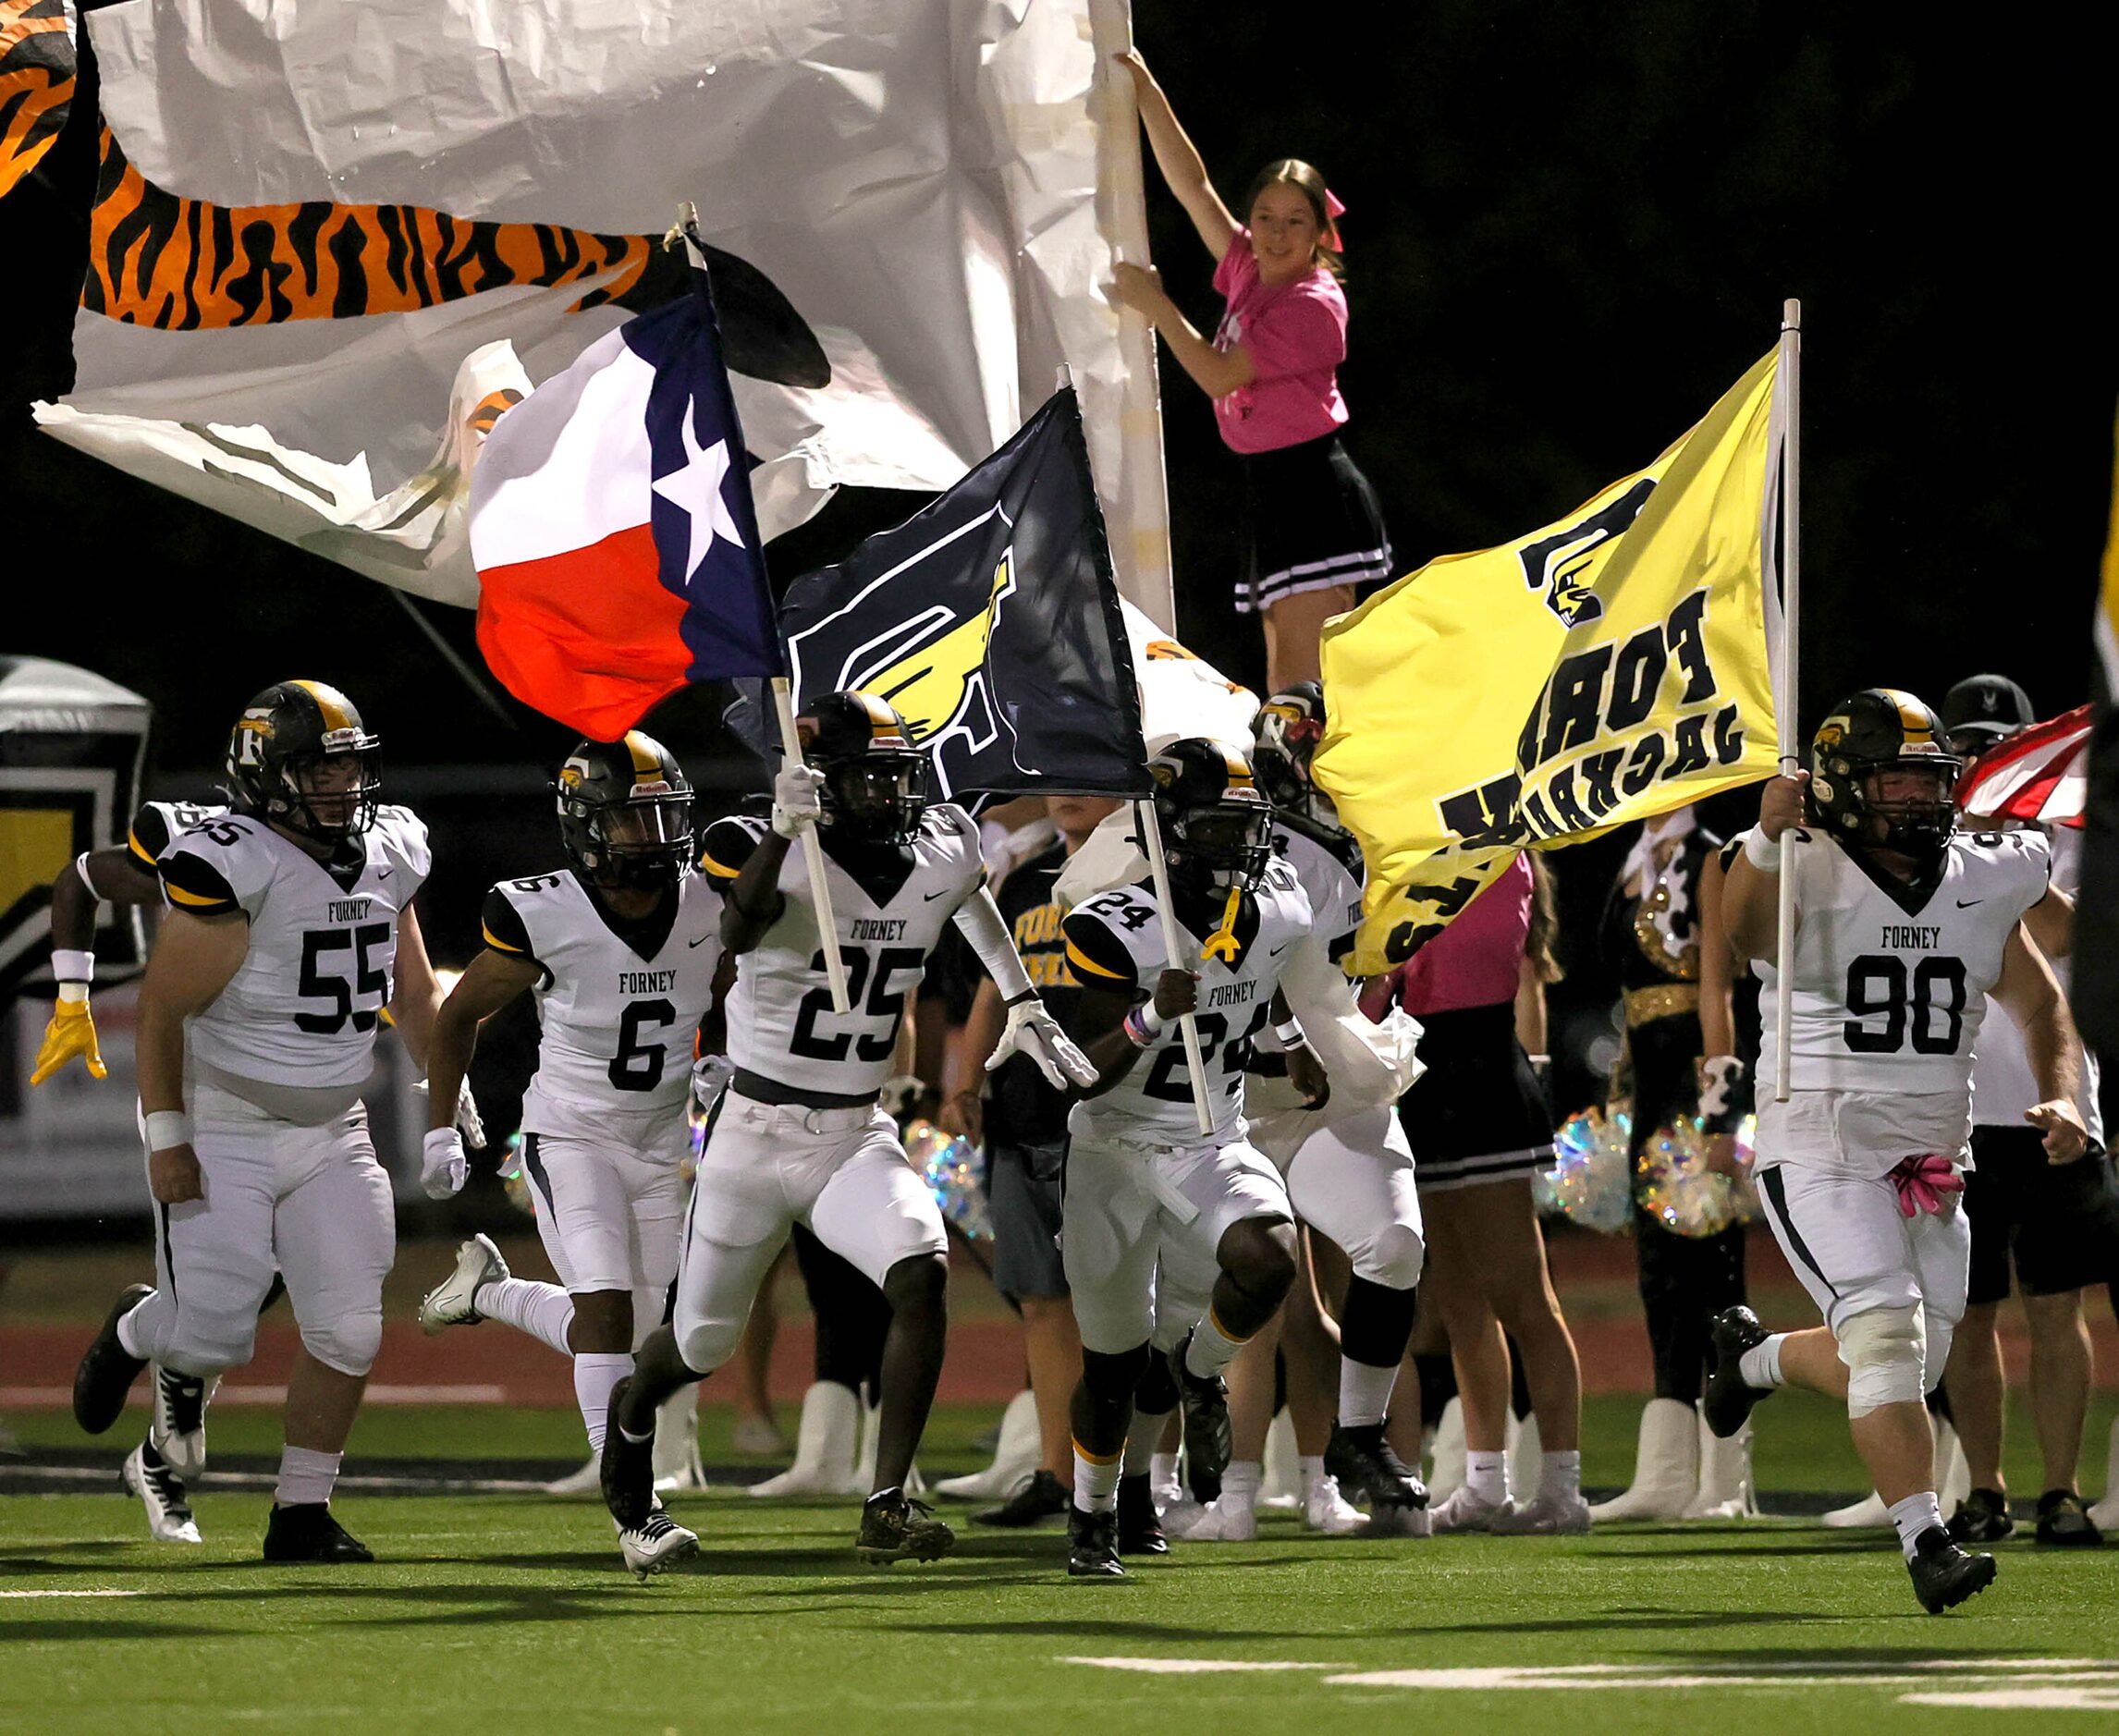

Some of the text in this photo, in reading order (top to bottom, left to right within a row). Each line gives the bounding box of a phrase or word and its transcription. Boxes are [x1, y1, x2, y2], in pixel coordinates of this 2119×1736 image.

[328, 899, 372, 923] FORNEY
[1086, 892, 1156, 932] 24
[851, 920, 907, 941] FORNEY
[1880, 926, 1941, 948] FORNEY
[294, 922, 390, 1034] 55
[619, 969, 677, 994] FORNEY
[1207, 980, 1257, 1008] FORNEY
[789, 946, 926, 1061] 25
[1843, 955, 1967, 1056] 90
[607, 998, 676, 1092] 6
